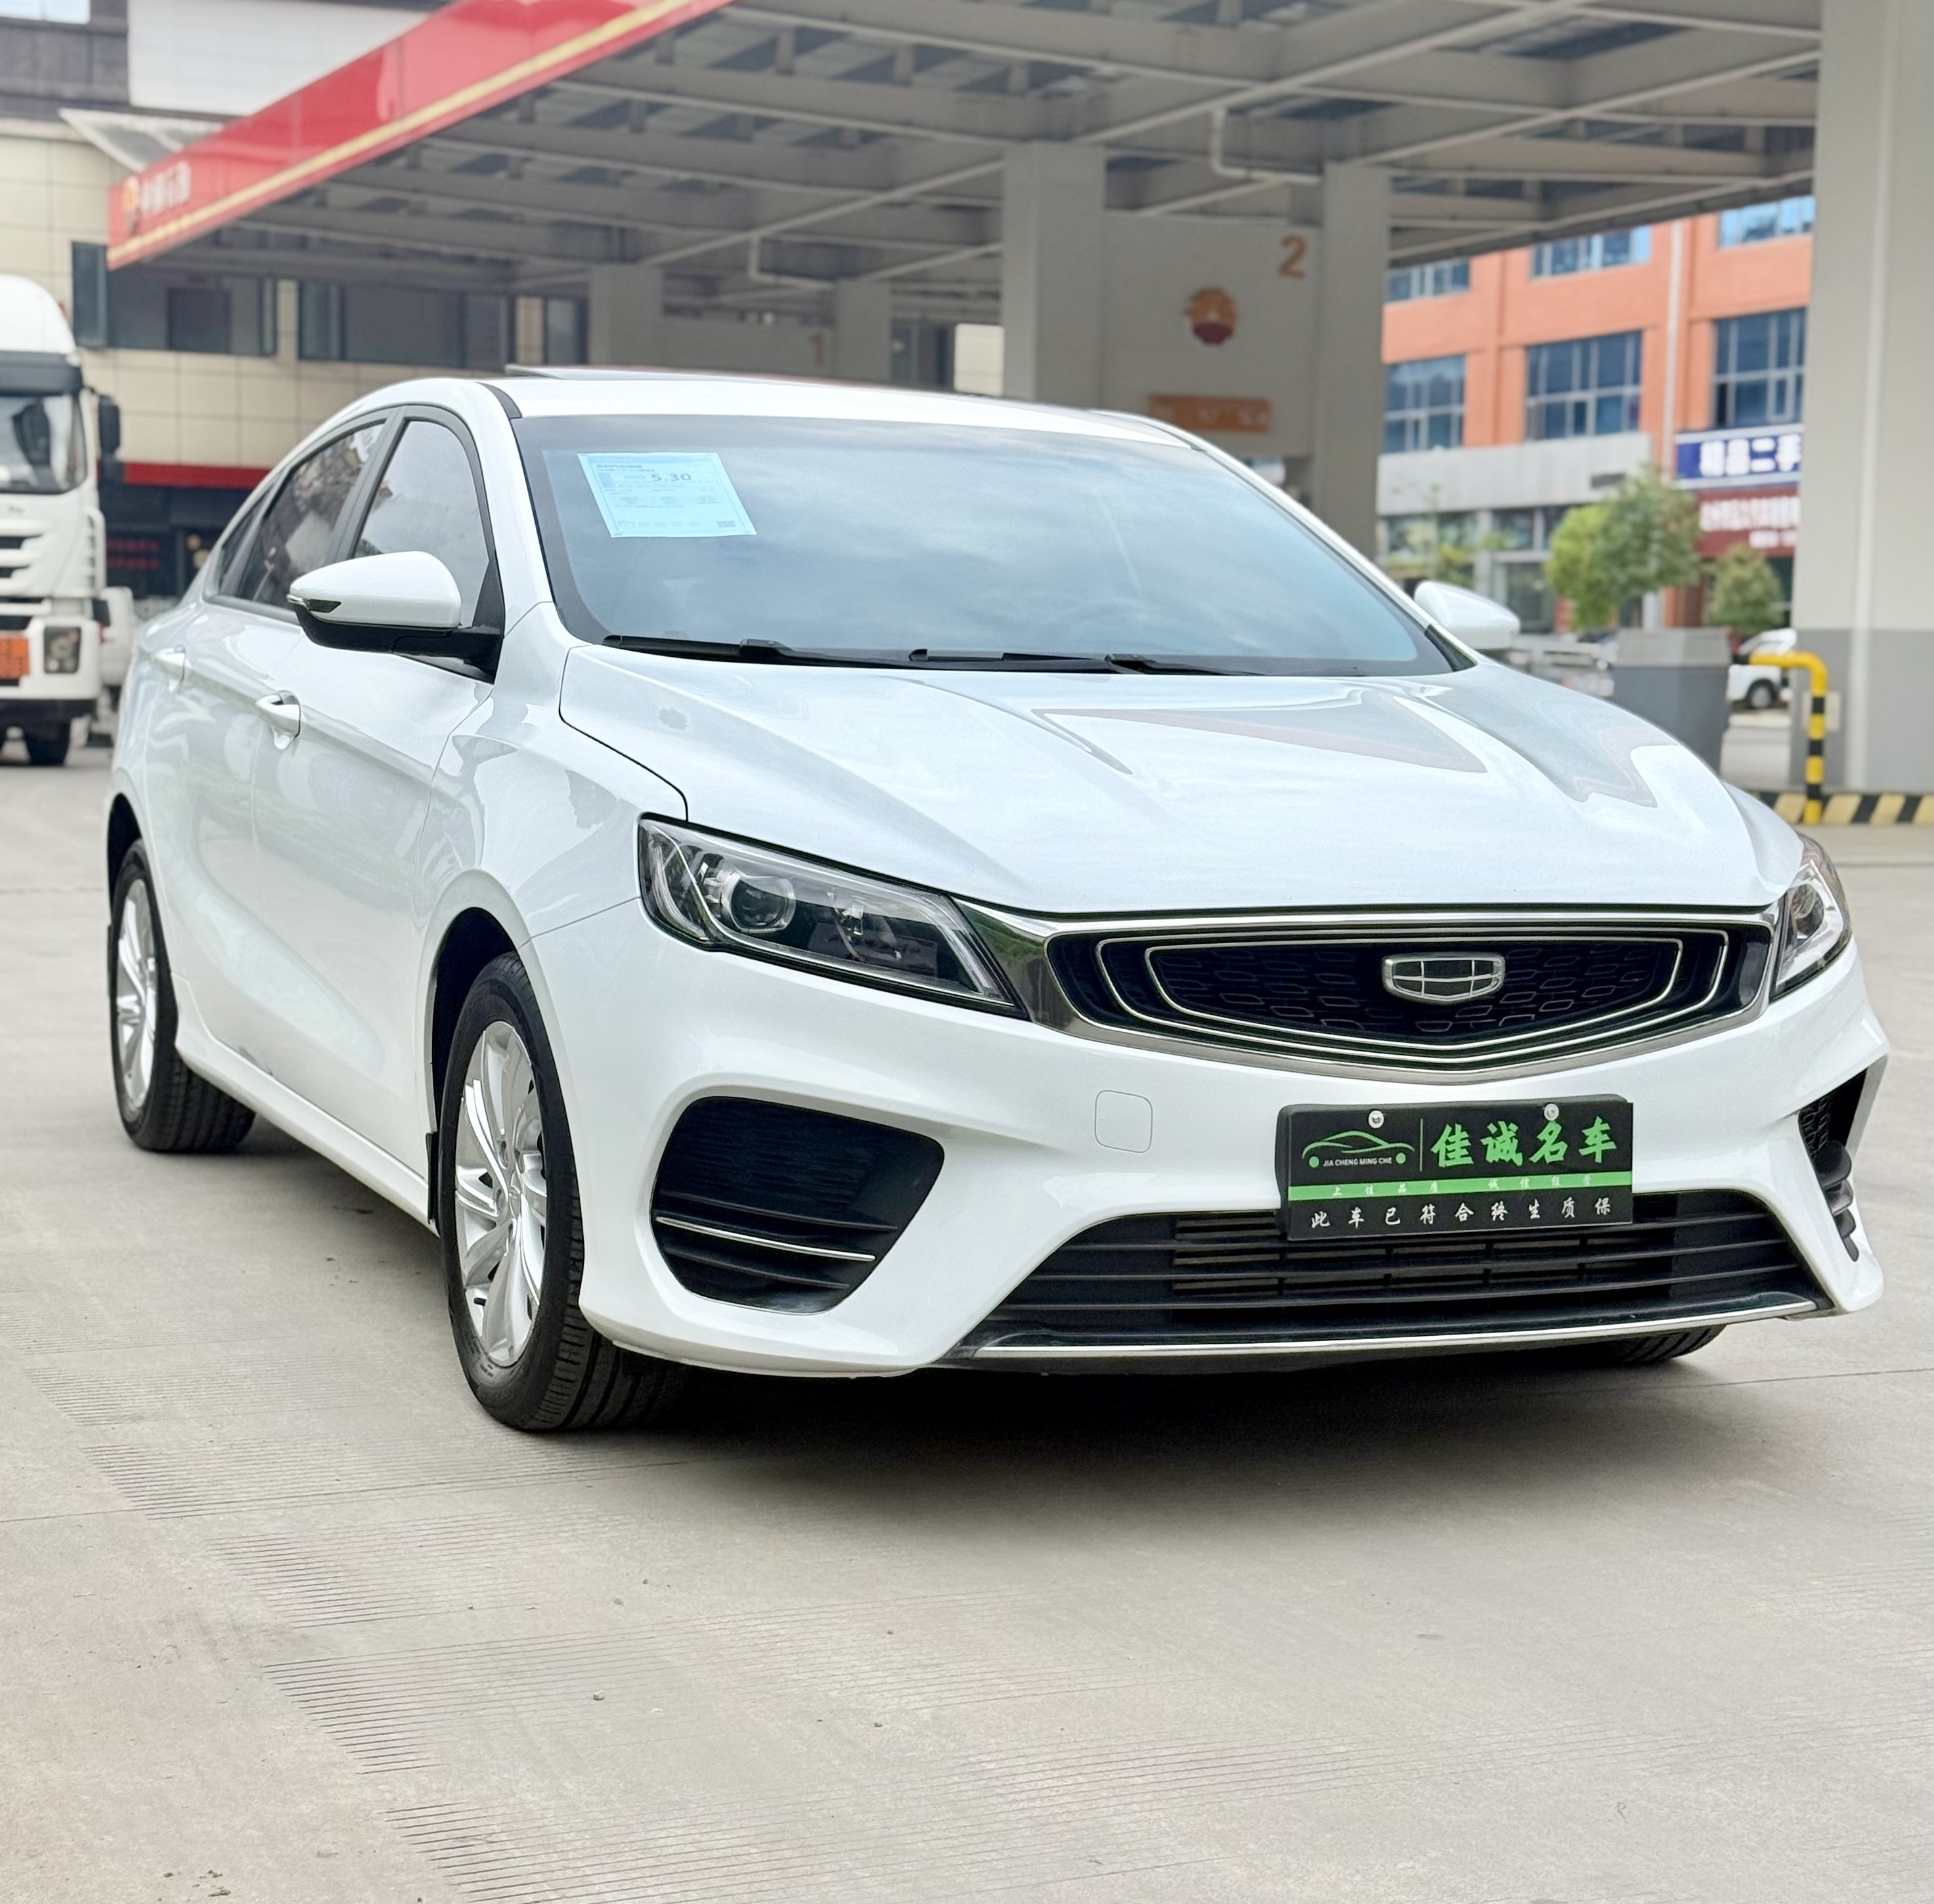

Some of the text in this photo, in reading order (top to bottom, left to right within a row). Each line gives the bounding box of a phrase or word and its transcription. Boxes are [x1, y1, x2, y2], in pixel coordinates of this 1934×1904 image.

[1279, 234, 1307, 279] 2
[810, 333, 825, 366] 1
[651, 474, 692, 482] 5.30
[1430, 1116, 1617, 1168] 佳诚名车
[1323, 1156, 1393, 1167] JIA CHENG MING CHE
[1311, 1196, 1612, 1229] 此车已符合终生质保
